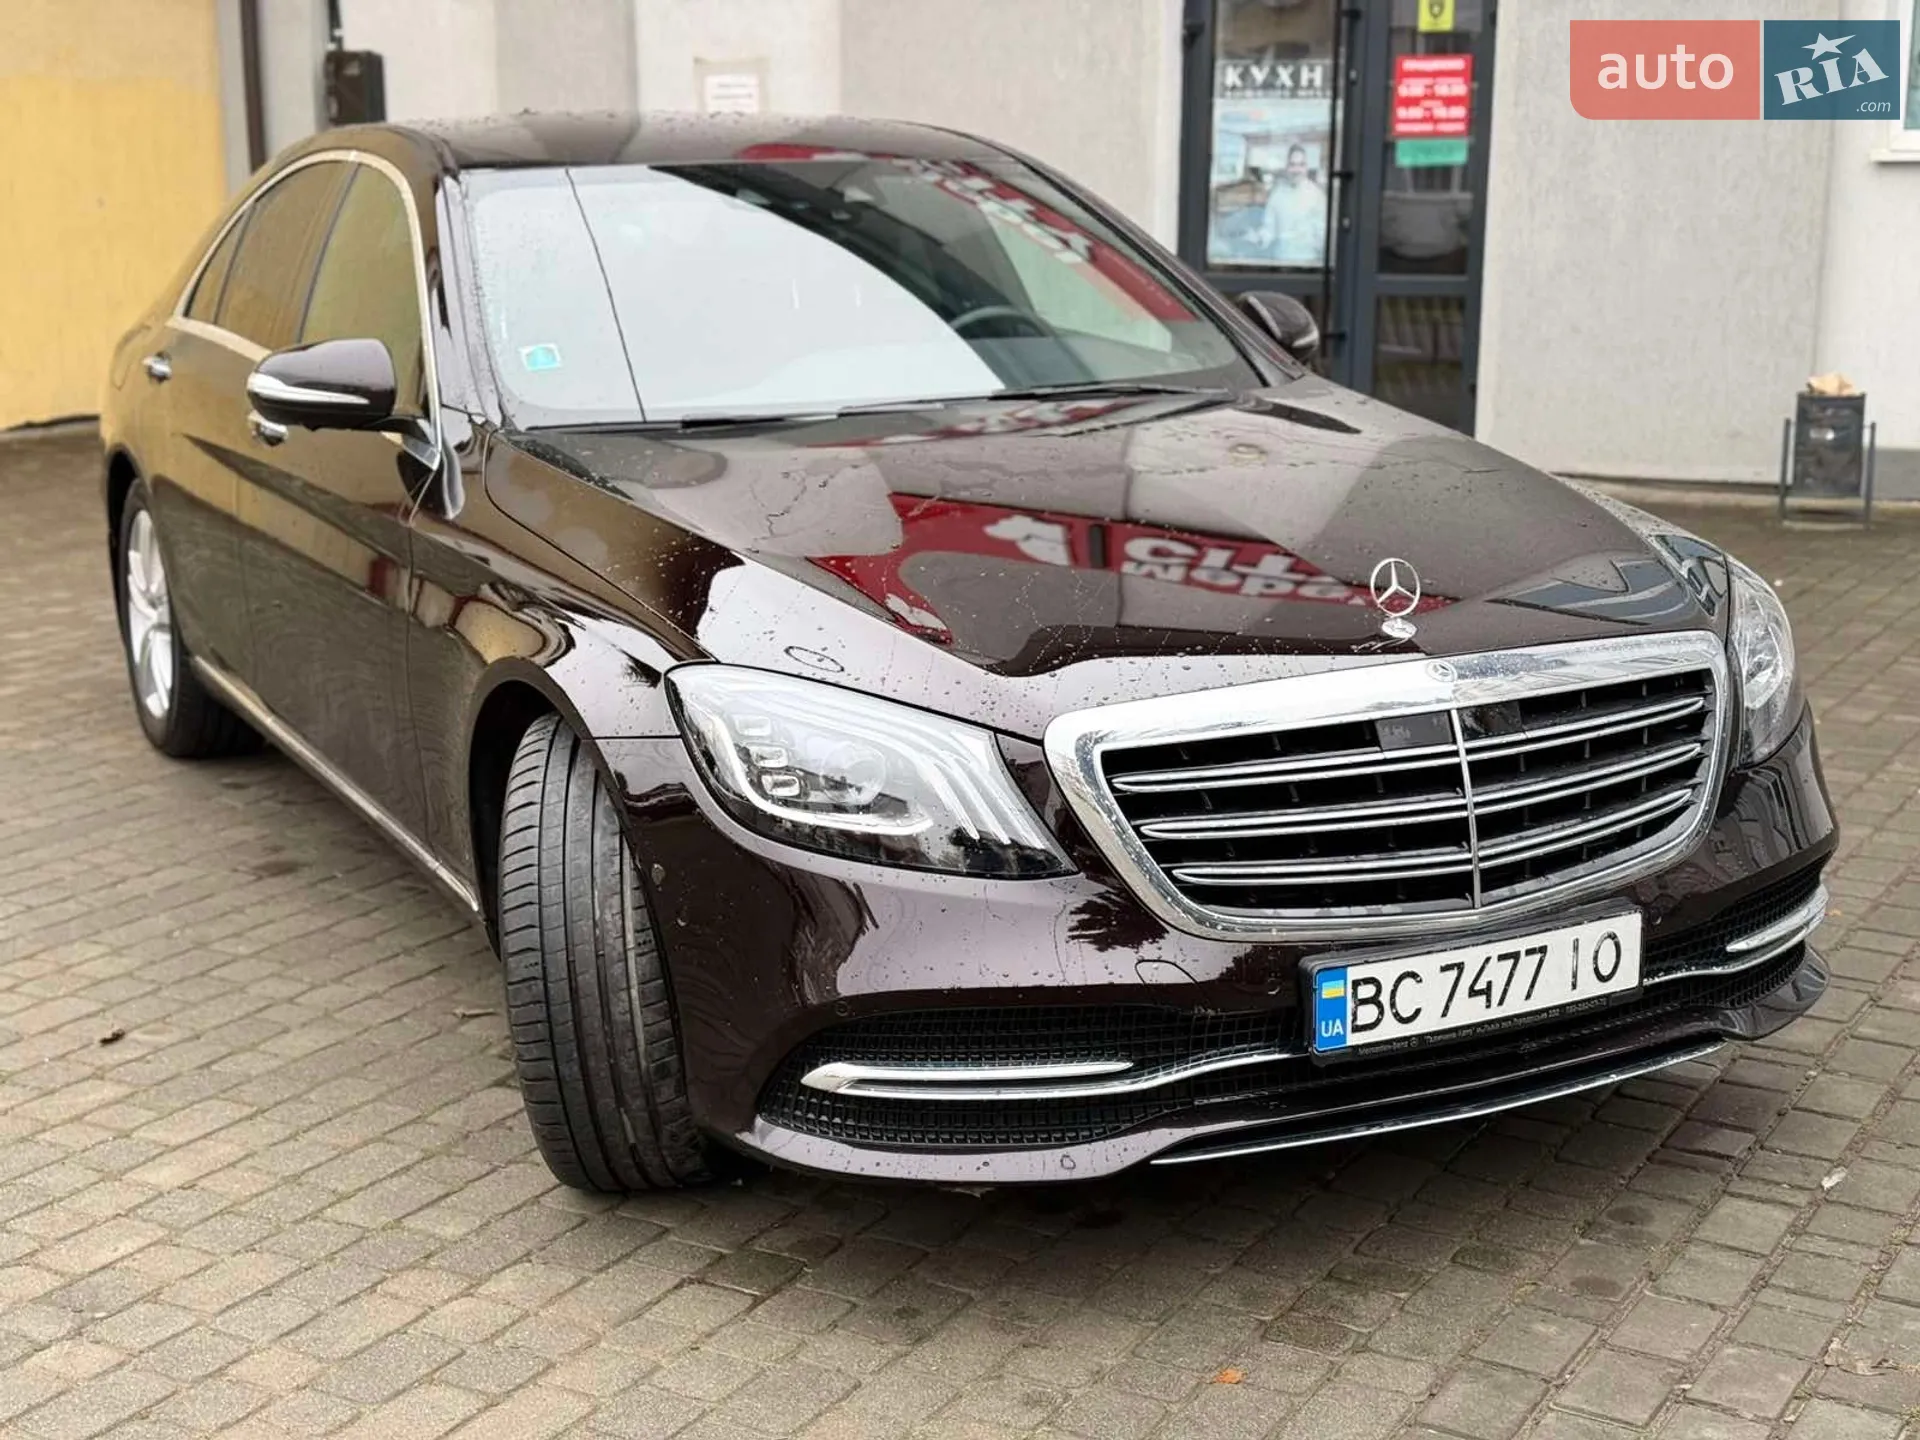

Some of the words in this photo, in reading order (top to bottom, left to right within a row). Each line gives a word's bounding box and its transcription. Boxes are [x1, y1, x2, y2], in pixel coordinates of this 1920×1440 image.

[1350, 970, 1424, 1034] BC
[1440, 944, 1548, 1018] 7477
[1571, 930, 1622, 991] IO
[1321, 1017, 1345, 1038] UA
